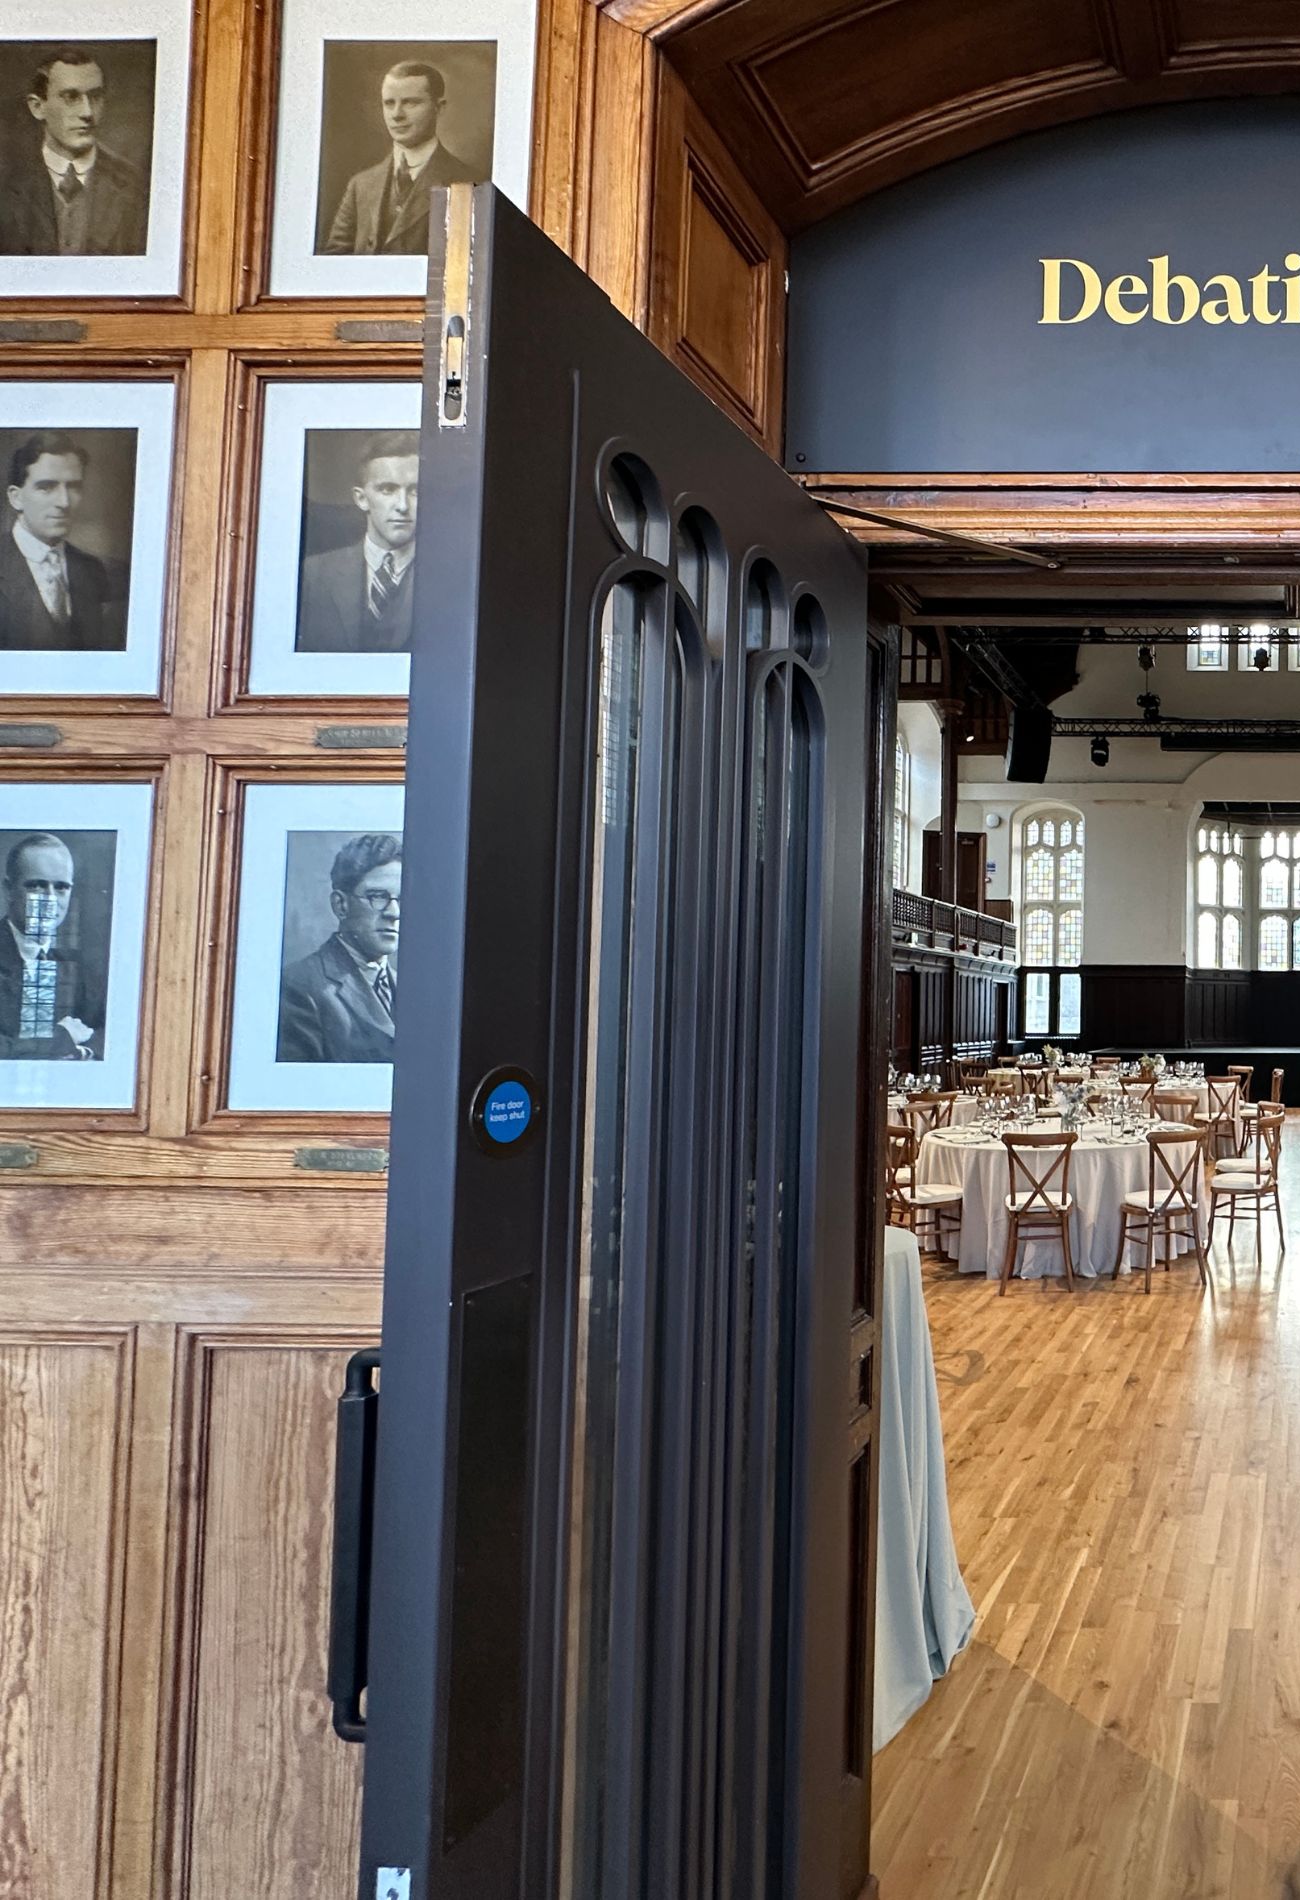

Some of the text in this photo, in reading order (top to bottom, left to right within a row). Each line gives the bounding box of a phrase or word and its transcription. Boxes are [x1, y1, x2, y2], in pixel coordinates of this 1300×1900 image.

[491, 1101, 524, 1111] Fire door
[490, 1110, 525, 1122] keep shut
